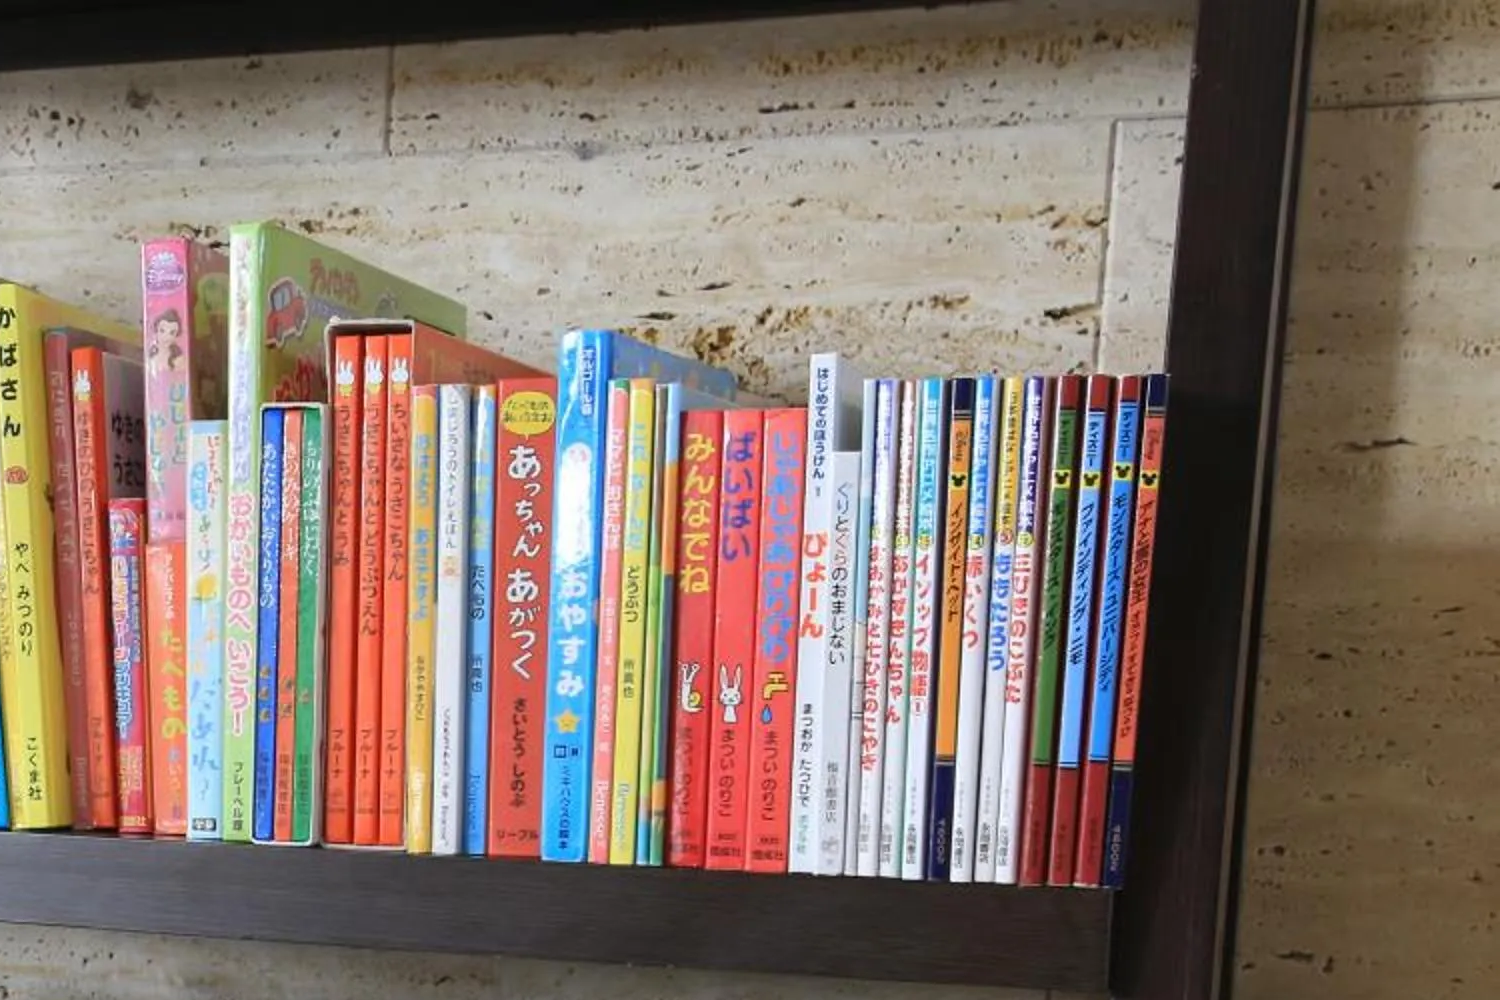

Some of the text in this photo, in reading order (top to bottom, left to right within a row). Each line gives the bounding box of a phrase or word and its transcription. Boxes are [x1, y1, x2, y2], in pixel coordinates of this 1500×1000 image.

[812, 366, 829, 480] はじめてのぼうけん
[680, 432, 716, 595] みんなでね
[721, 430, 756, 563] ばいばい
[503, 444, 544, 680] あっちゃん あがつく
[800, 531, 829, 639] ぴょーん
[962, 554, 984, 649] 赤いくつ
[17, 586, 34, 656] みつのり
[555, 566, 590, 698] おやすみ
[25, 737, 43, 801] こぐま社
[231, 762, 245, 832] フレーベル館
[761, 730, 779, 822] まついのりこ
